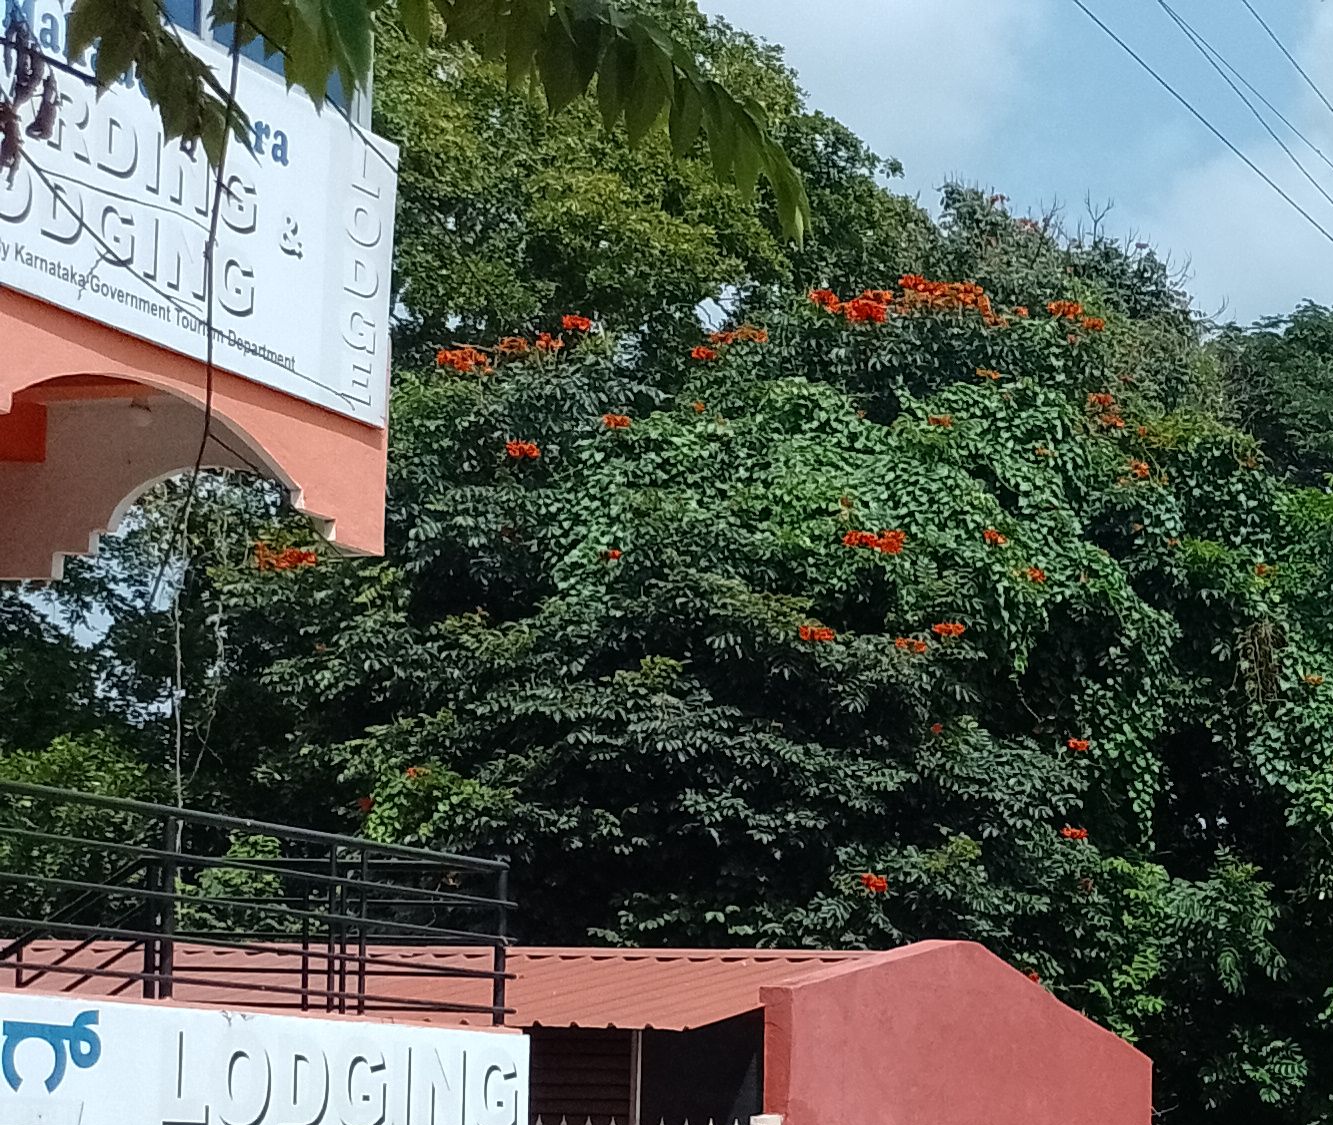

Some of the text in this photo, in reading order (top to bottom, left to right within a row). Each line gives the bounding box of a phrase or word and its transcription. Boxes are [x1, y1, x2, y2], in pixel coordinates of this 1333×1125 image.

[22, 86, 303, 259] RDING &
[14, 243, 90, 289] Karnataka
[89, 274, 172, 323] Government
[174, 308, 225, 344] Tourim
[227, 330, 297, 373] Department
